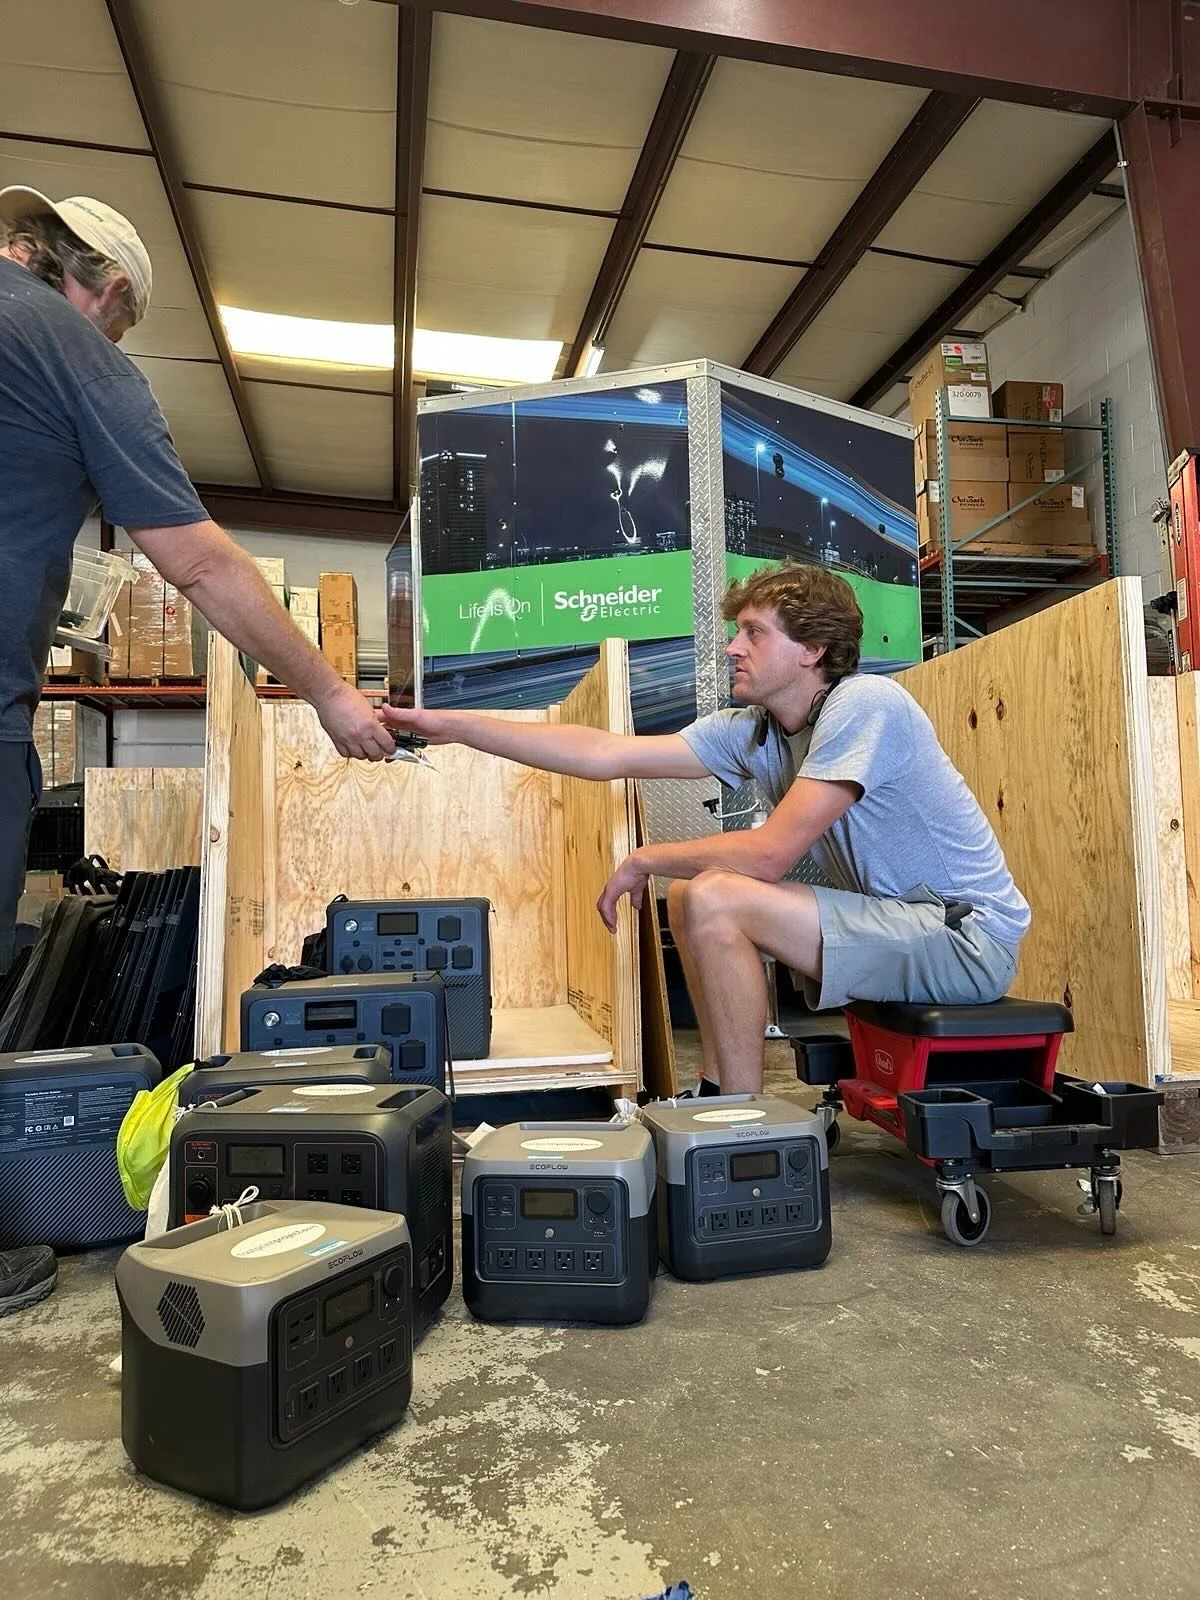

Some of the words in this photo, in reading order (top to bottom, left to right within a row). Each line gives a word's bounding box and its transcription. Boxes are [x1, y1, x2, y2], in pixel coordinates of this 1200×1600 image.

[951, 390, 983, 400] 320-0079
[458, 601, 486, 620] Life
[507, 597, 531, 615] On
[554, 584, 663, 611] Schneider
[600, 605, 661, 619] Electric
[327, 1248, 364, 1270] ECOFLOW
